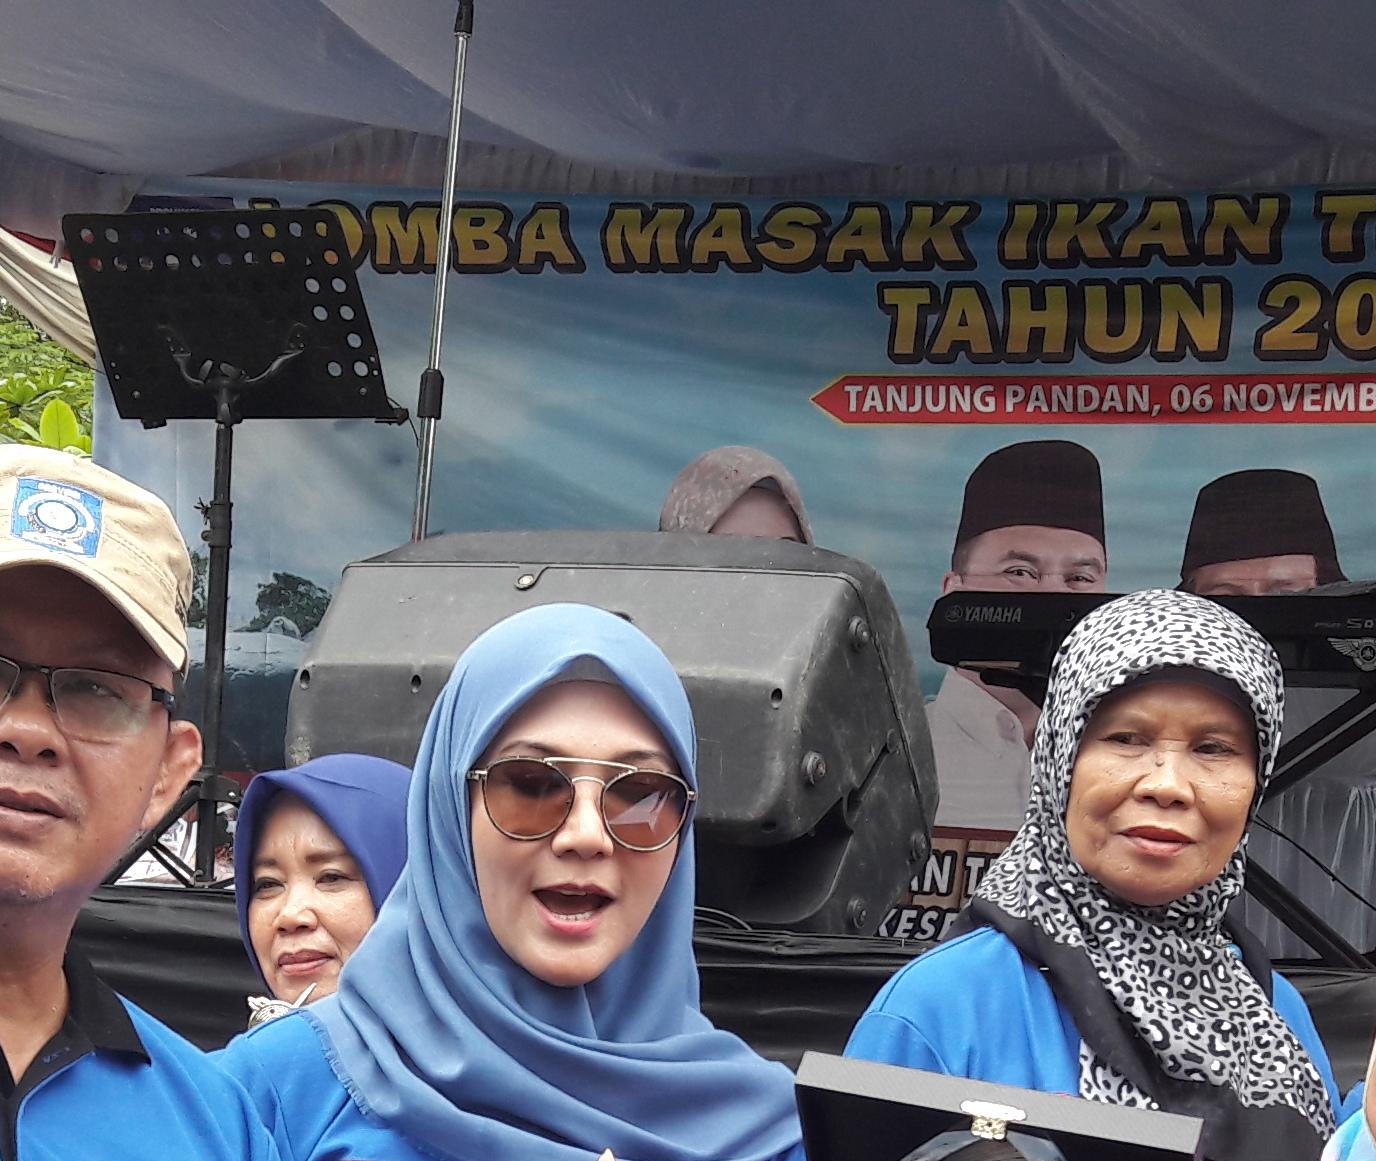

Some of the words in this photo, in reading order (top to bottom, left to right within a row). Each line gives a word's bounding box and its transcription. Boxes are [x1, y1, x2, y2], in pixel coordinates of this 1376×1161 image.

[248, 199, 586, 273] MBA
[601, 199, 980, 273] MASAK
[997, 193, 1290, 269] IKAN
[877, 278, 1230, 364] TAHUN
[844, 384, 996, 413] TANJUNG
[1005, 384, 1161, 417] PANDAN,
[1170, 383, 1214, 413] 06
[965, 606, 1022, 624] YAMAHA
